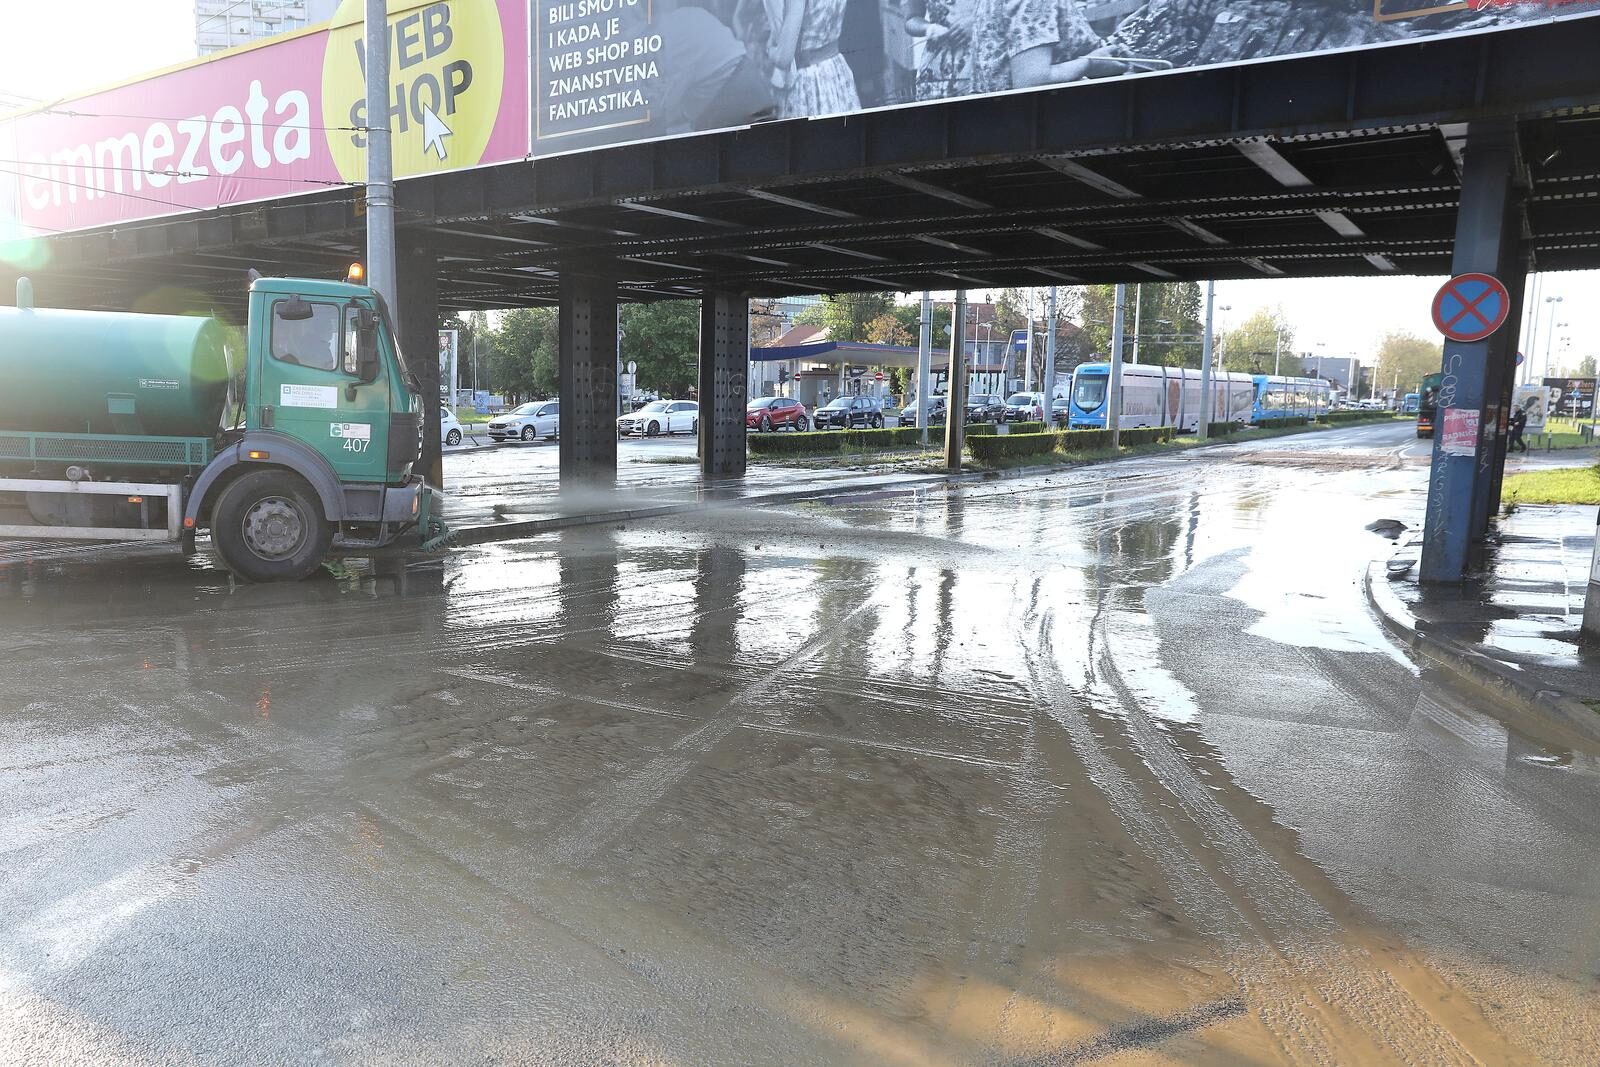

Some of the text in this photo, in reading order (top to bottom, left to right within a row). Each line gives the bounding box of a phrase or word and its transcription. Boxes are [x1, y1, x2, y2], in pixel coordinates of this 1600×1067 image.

[549, 3, 574, 24] BILI
[578, 0, 613, 17] SMO
[549, 18, 620, 49] I KADA JE
[549, 34, 662, 72] WEB SHOP BIO
[549, 61, 659, 97] ZNANSTVENA
[350, 60, 473, 148] SHOP
[549, 89, 649, 121] FANTASTIKA.
[22, 79, 311, 210] emmezeta
[343, 438, 370, 452] 407
